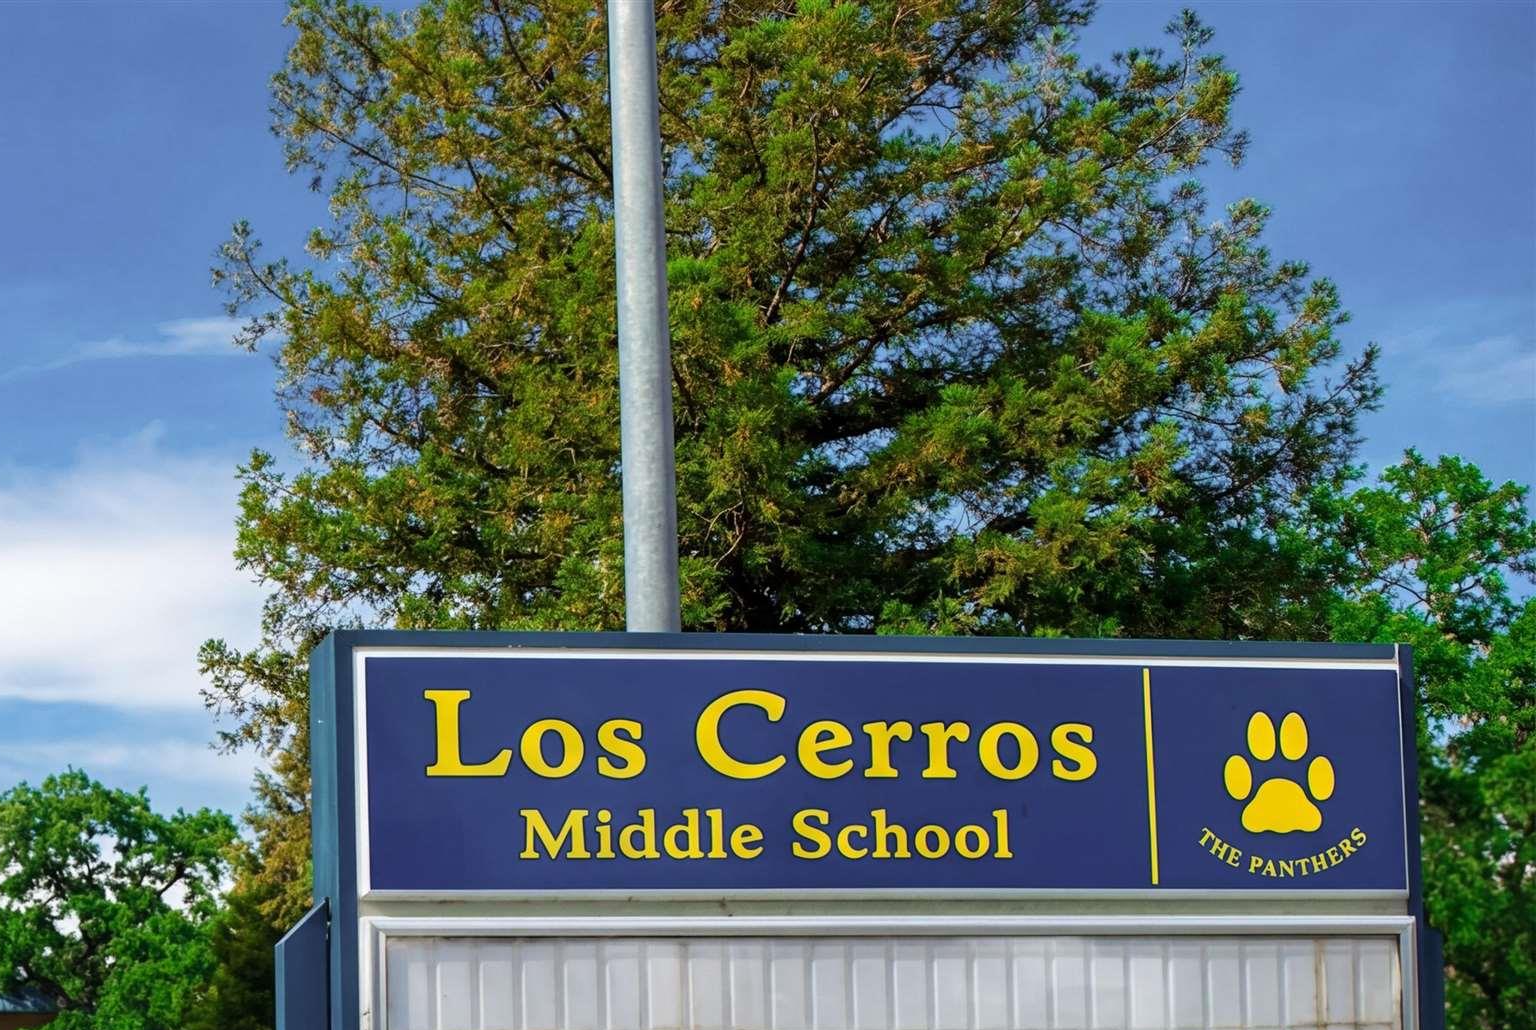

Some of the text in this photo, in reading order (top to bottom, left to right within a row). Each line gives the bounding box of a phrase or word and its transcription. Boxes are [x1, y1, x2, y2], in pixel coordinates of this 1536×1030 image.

[424, 688, 1098, 781] Los Cerros
[520, 808, 1013, 860] Middle School
[1198, 828, 1367, 877] THE PANTHERS
